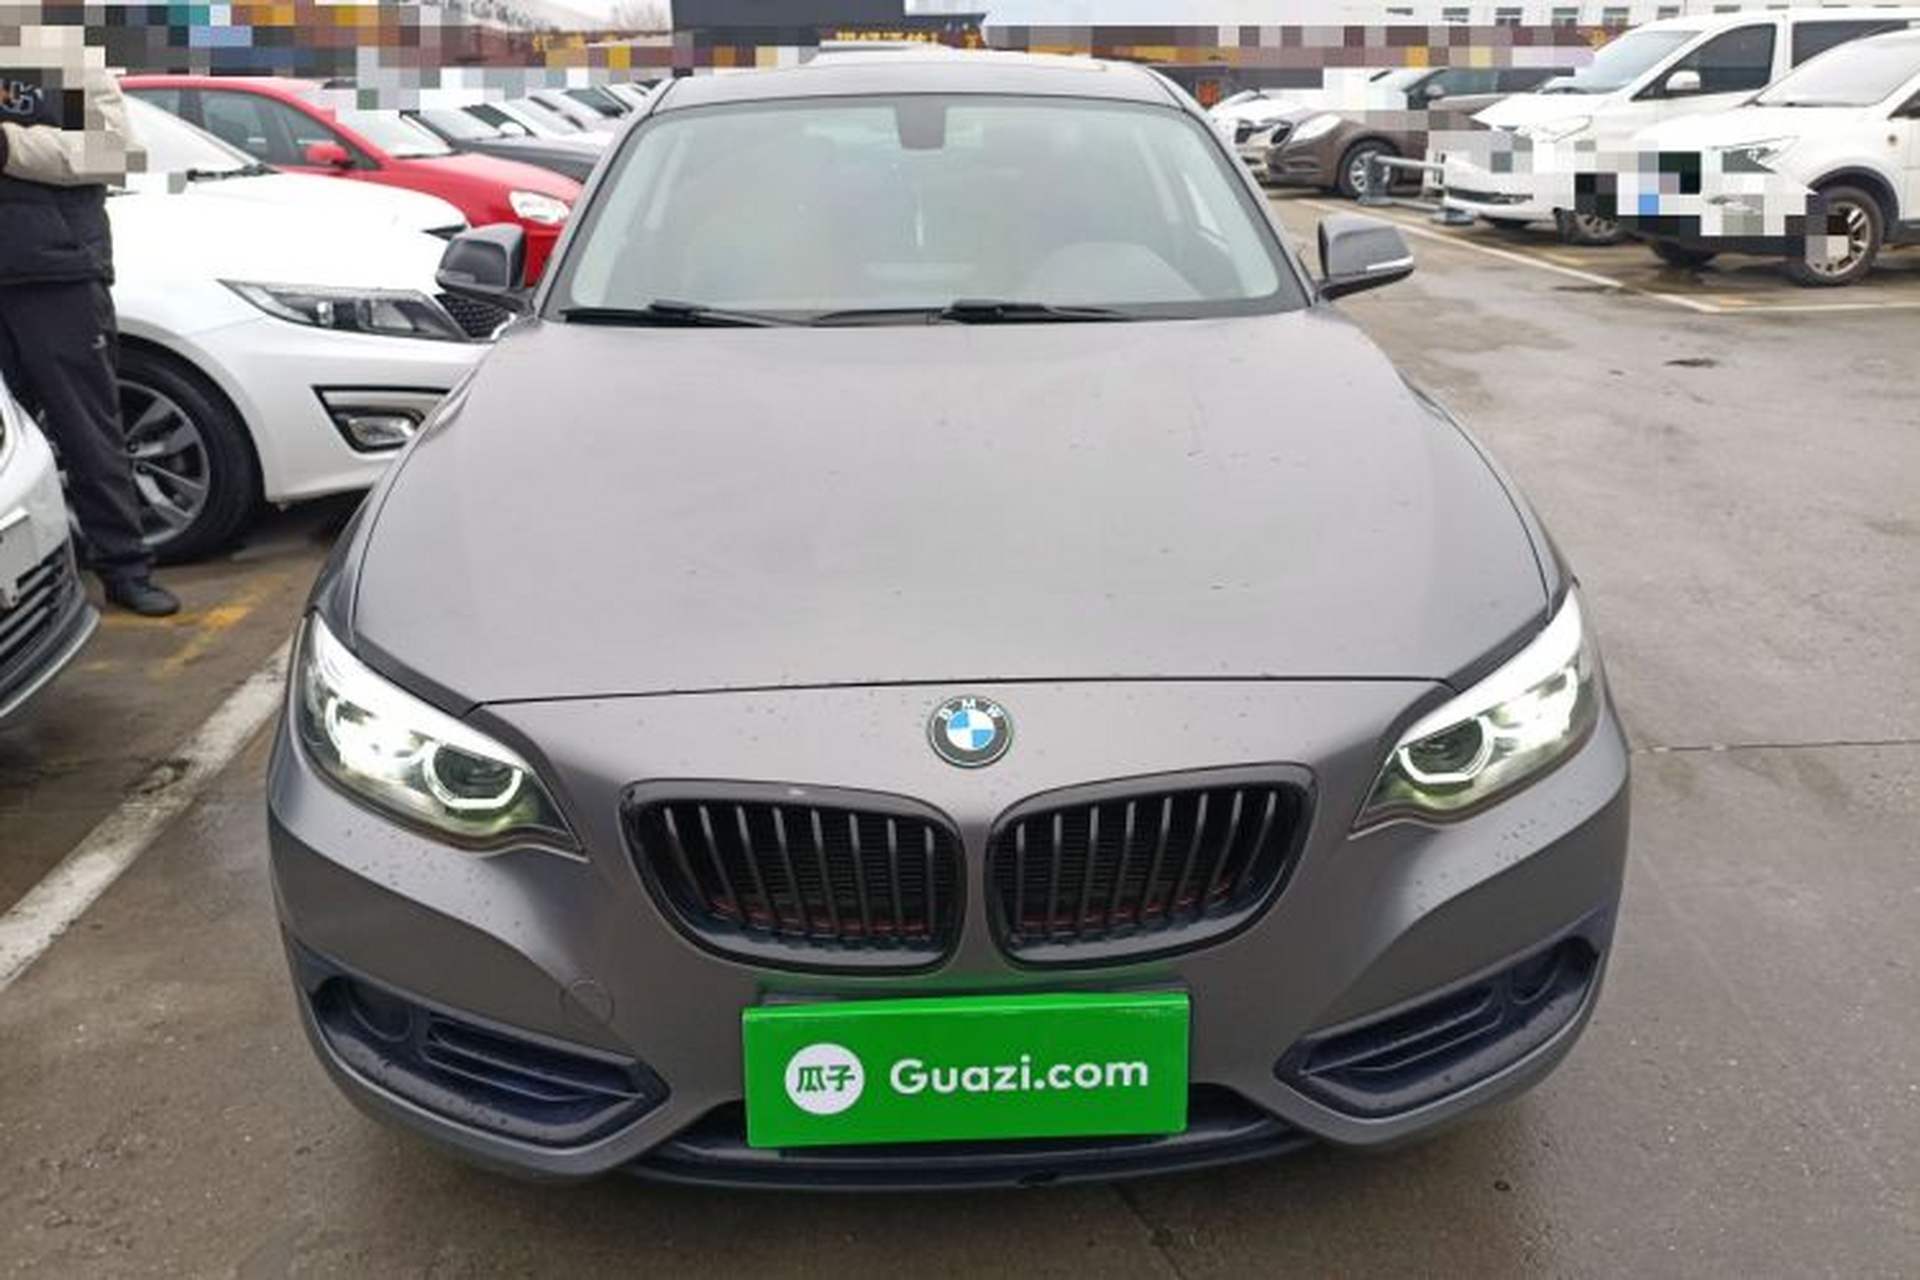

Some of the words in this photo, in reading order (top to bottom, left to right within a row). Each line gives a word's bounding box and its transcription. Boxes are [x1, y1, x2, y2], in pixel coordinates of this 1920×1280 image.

[938, 698, 1004, 720] BMW
[796, 1065, 856, 1092] 瓜子
[890, 1054, 1149, 1094] Guazi.com
